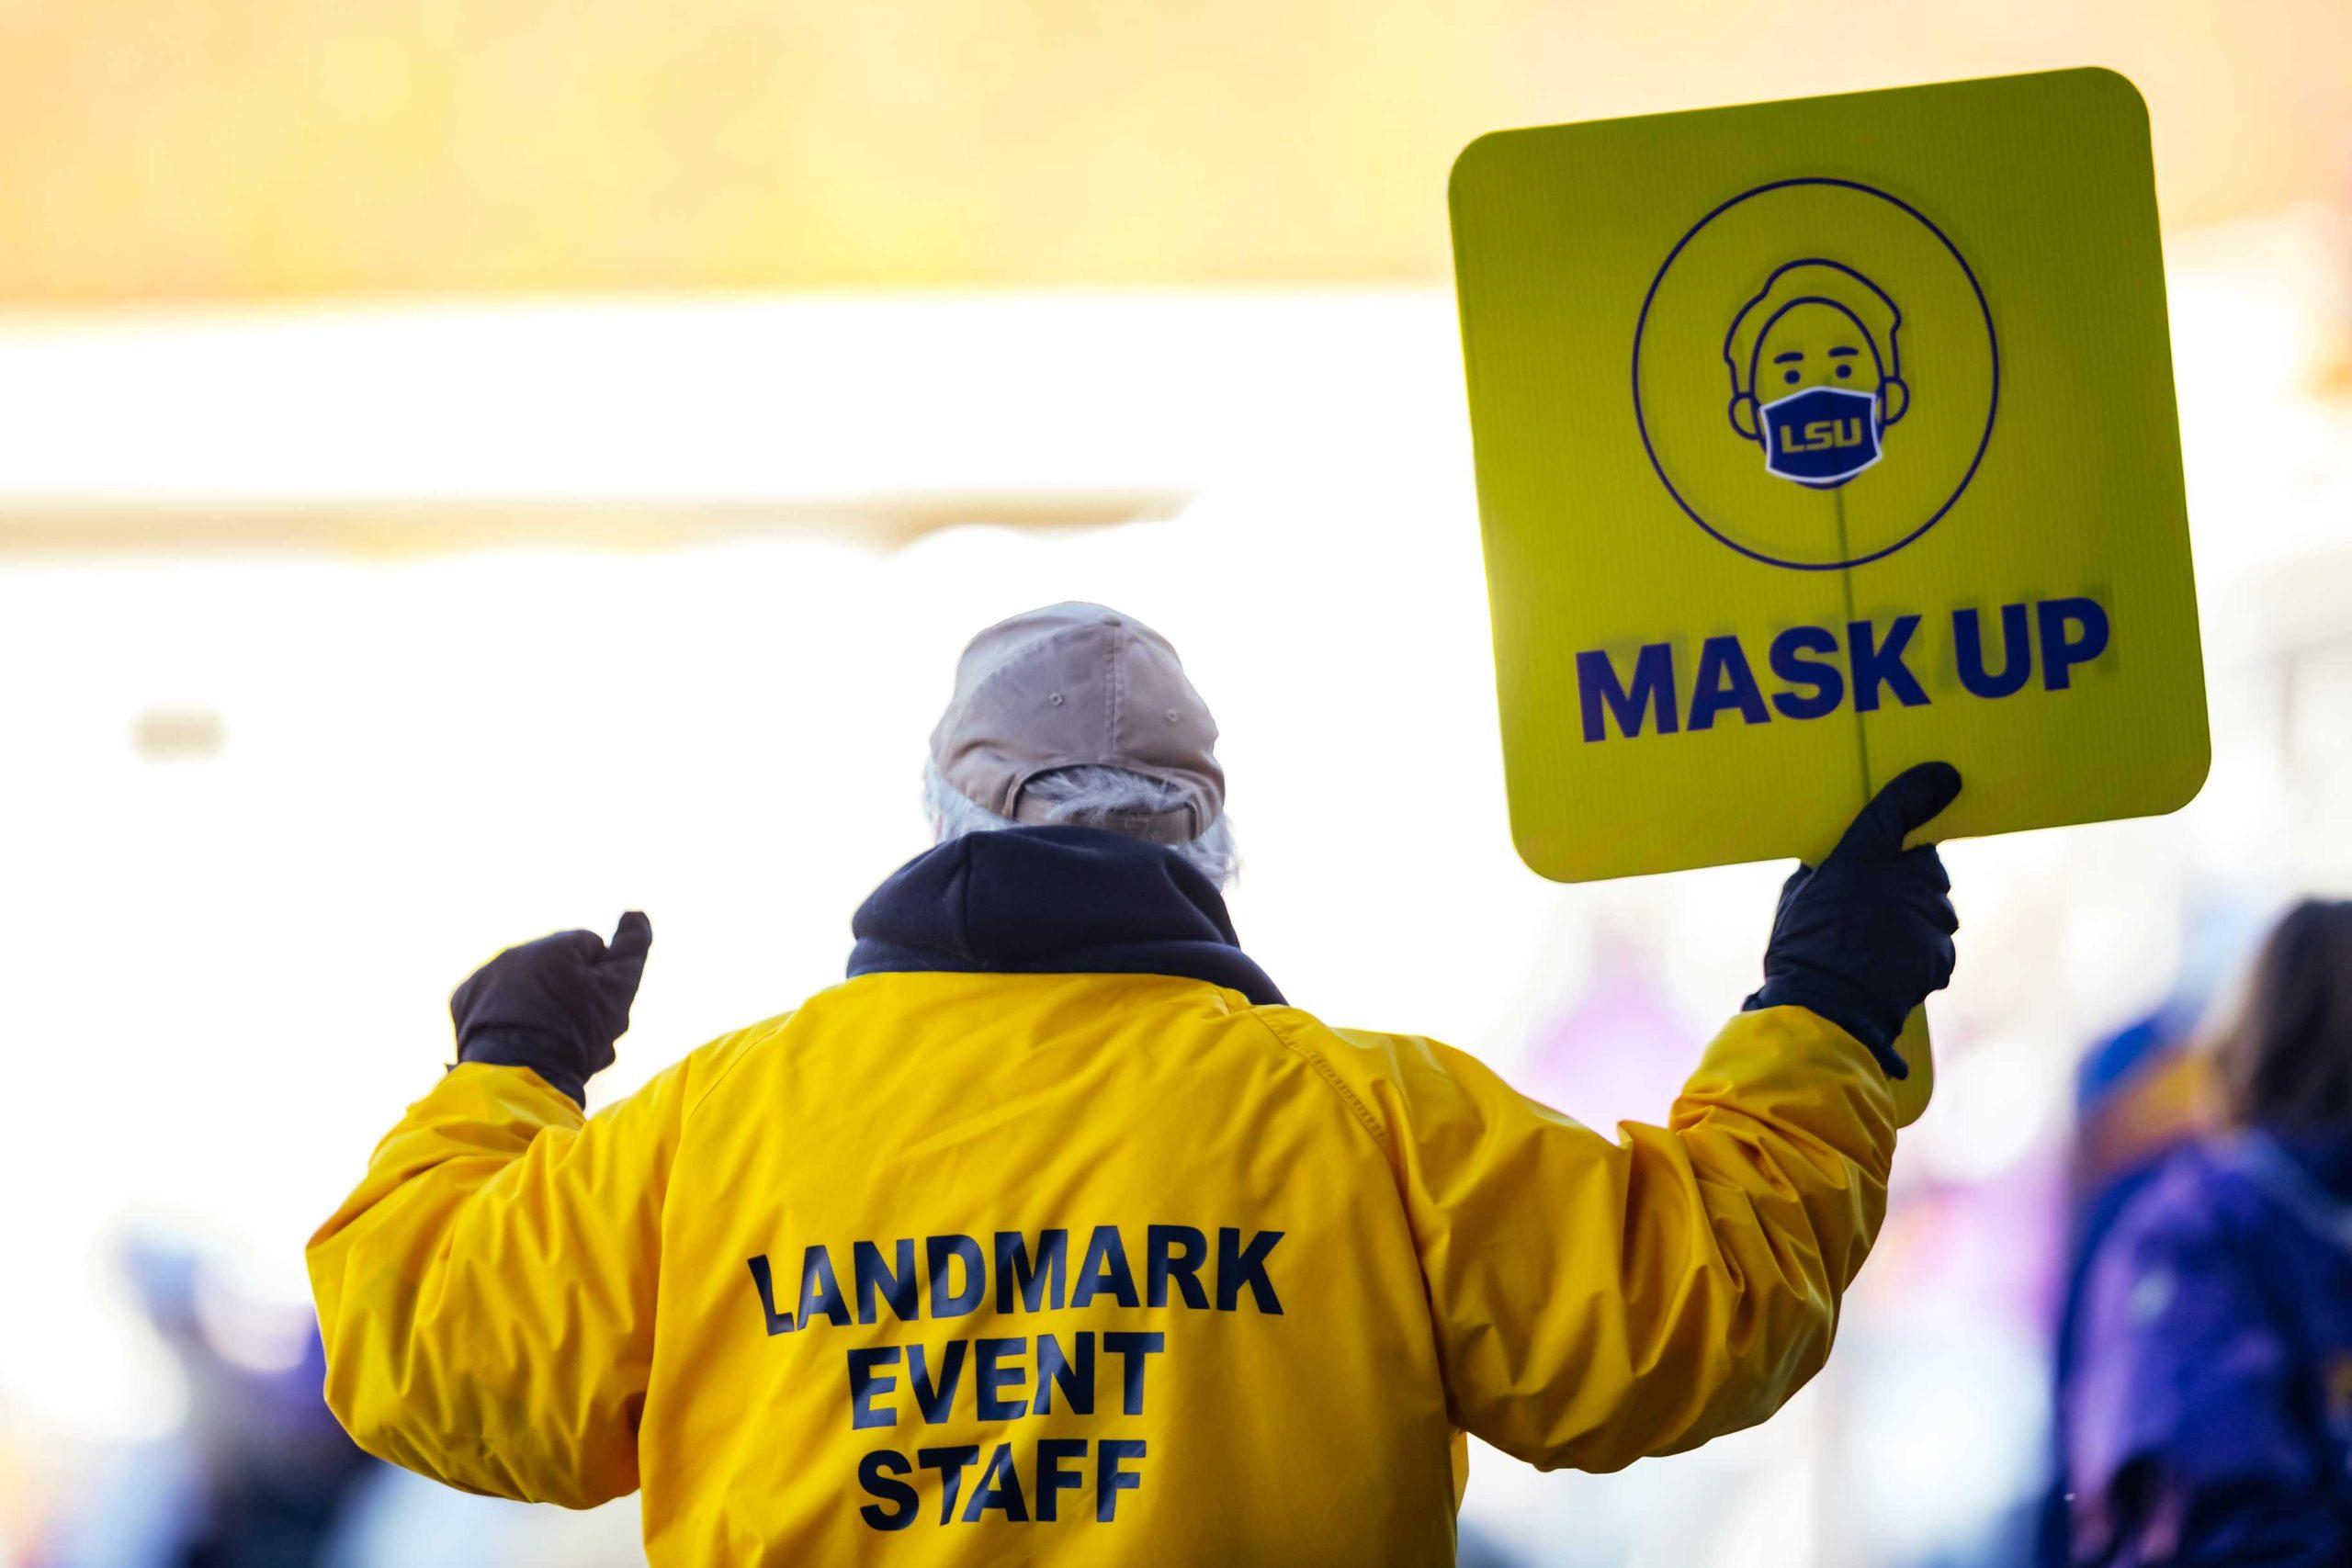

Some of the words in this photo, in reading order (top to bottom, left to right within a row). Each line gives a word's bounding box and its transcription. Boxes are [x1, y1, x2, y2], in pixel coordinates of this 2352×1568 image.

[1780, 417, 1862, 454] LSU
[1575, 614, 1933, 743] MASK
[1951, 597, 2111, 699] UP
[747, 1224, 1286, 1337] LANDMARK
[847, 1331, 1165, 1430] EVENT
[858, 1438, 1147, 1531] STAFF
